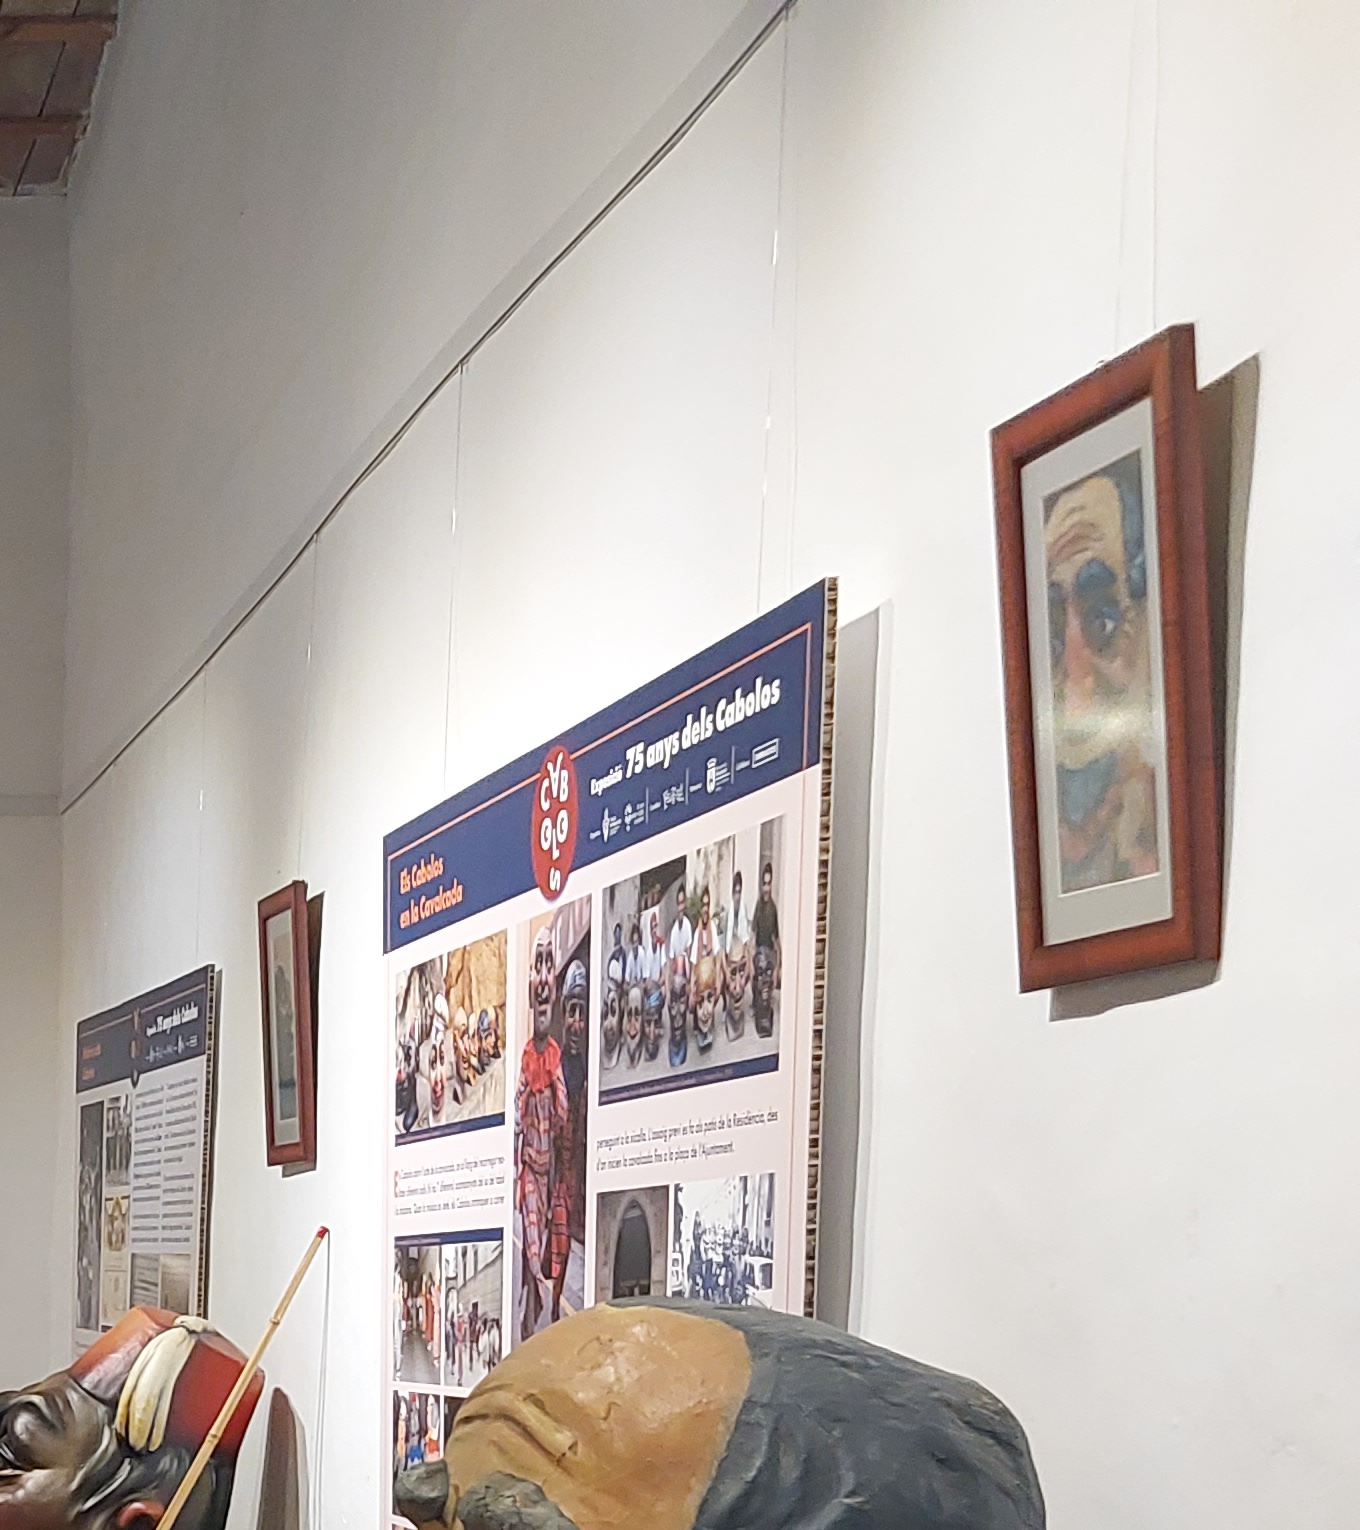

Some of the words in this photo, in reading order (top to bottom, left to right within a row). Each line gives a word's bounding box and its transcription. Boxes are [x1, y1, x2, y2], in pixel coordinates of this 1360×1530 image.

[625, 741, 644, 778] 75
[646, 731, 680, 769] anys
[681, 705, 714, 750] dels
[715, 676, 780, 732] Cabolos
[400, 867, 411, 894] Els
[411, 853, 444, 888] Cabolos
[420, 878, 463, 919] Cavalcada
